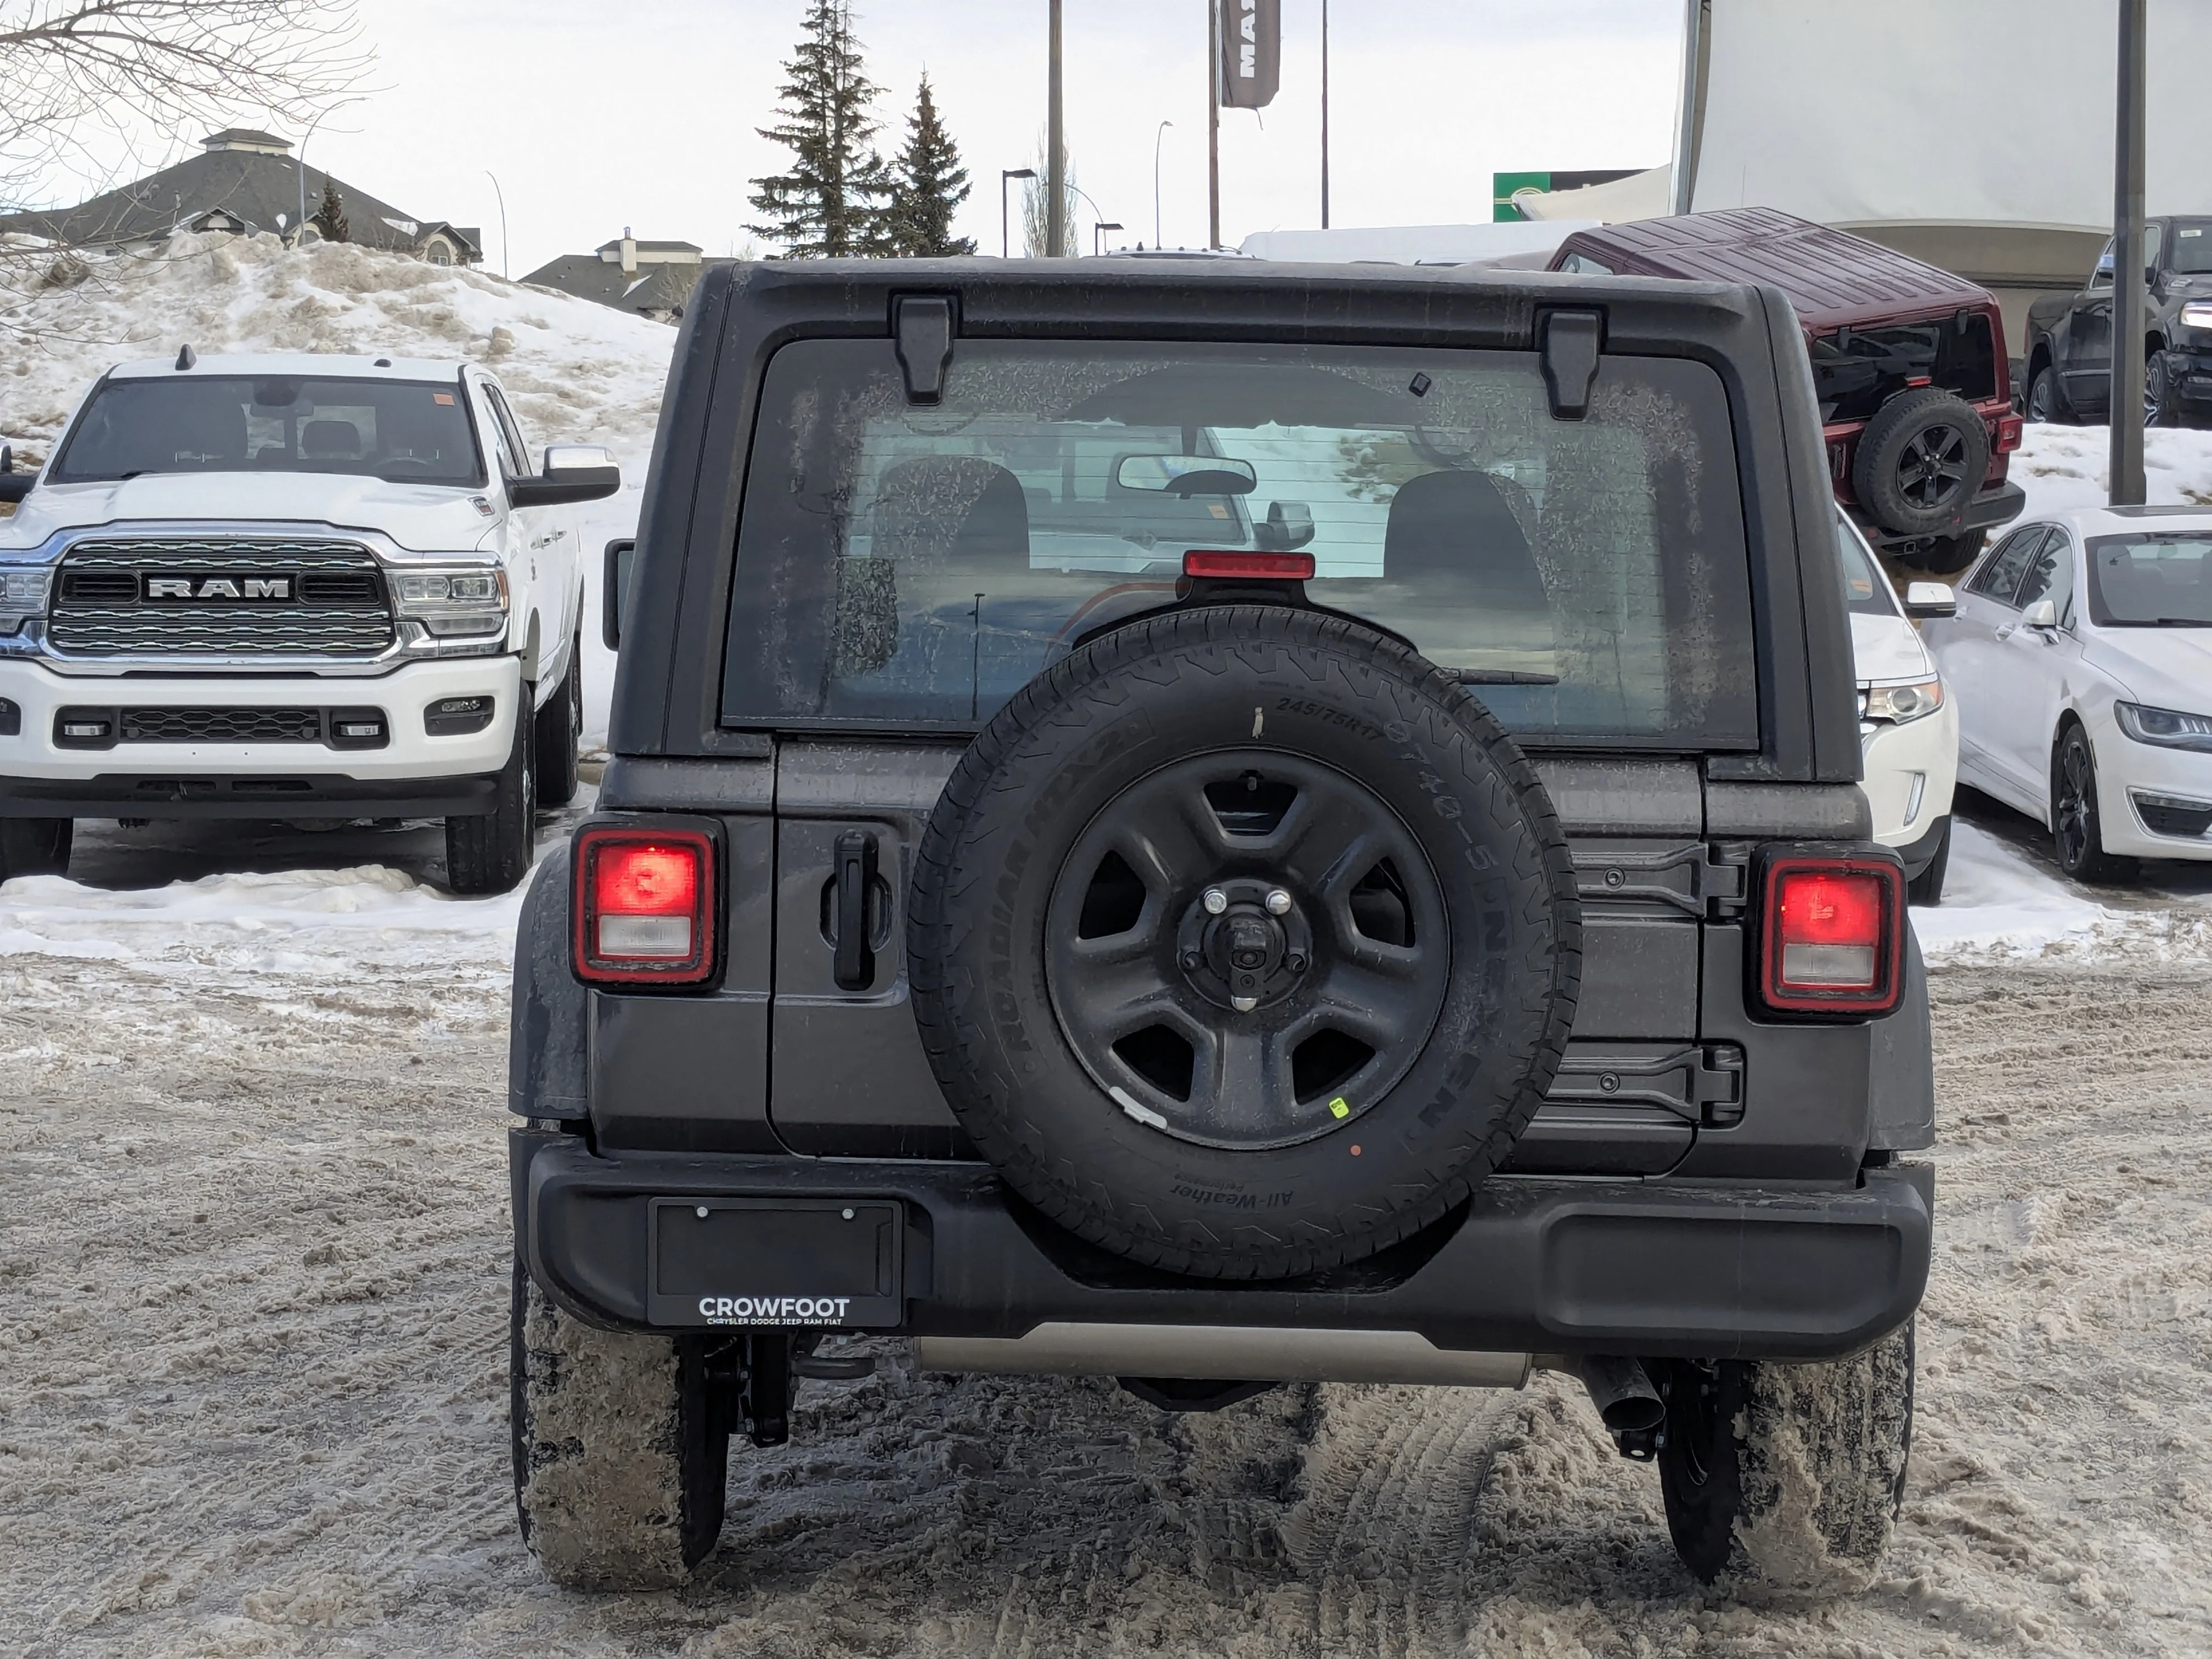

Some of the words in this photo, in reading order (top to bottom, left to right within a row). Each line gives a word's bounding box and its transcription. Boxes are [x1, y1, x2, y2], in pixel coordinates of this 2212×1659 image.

[148, 579, 289, 597] RAM
[1170, 1184, 1295, 1209] All-Weather
[699, 1297, 850, 1317] CROWFOOT
